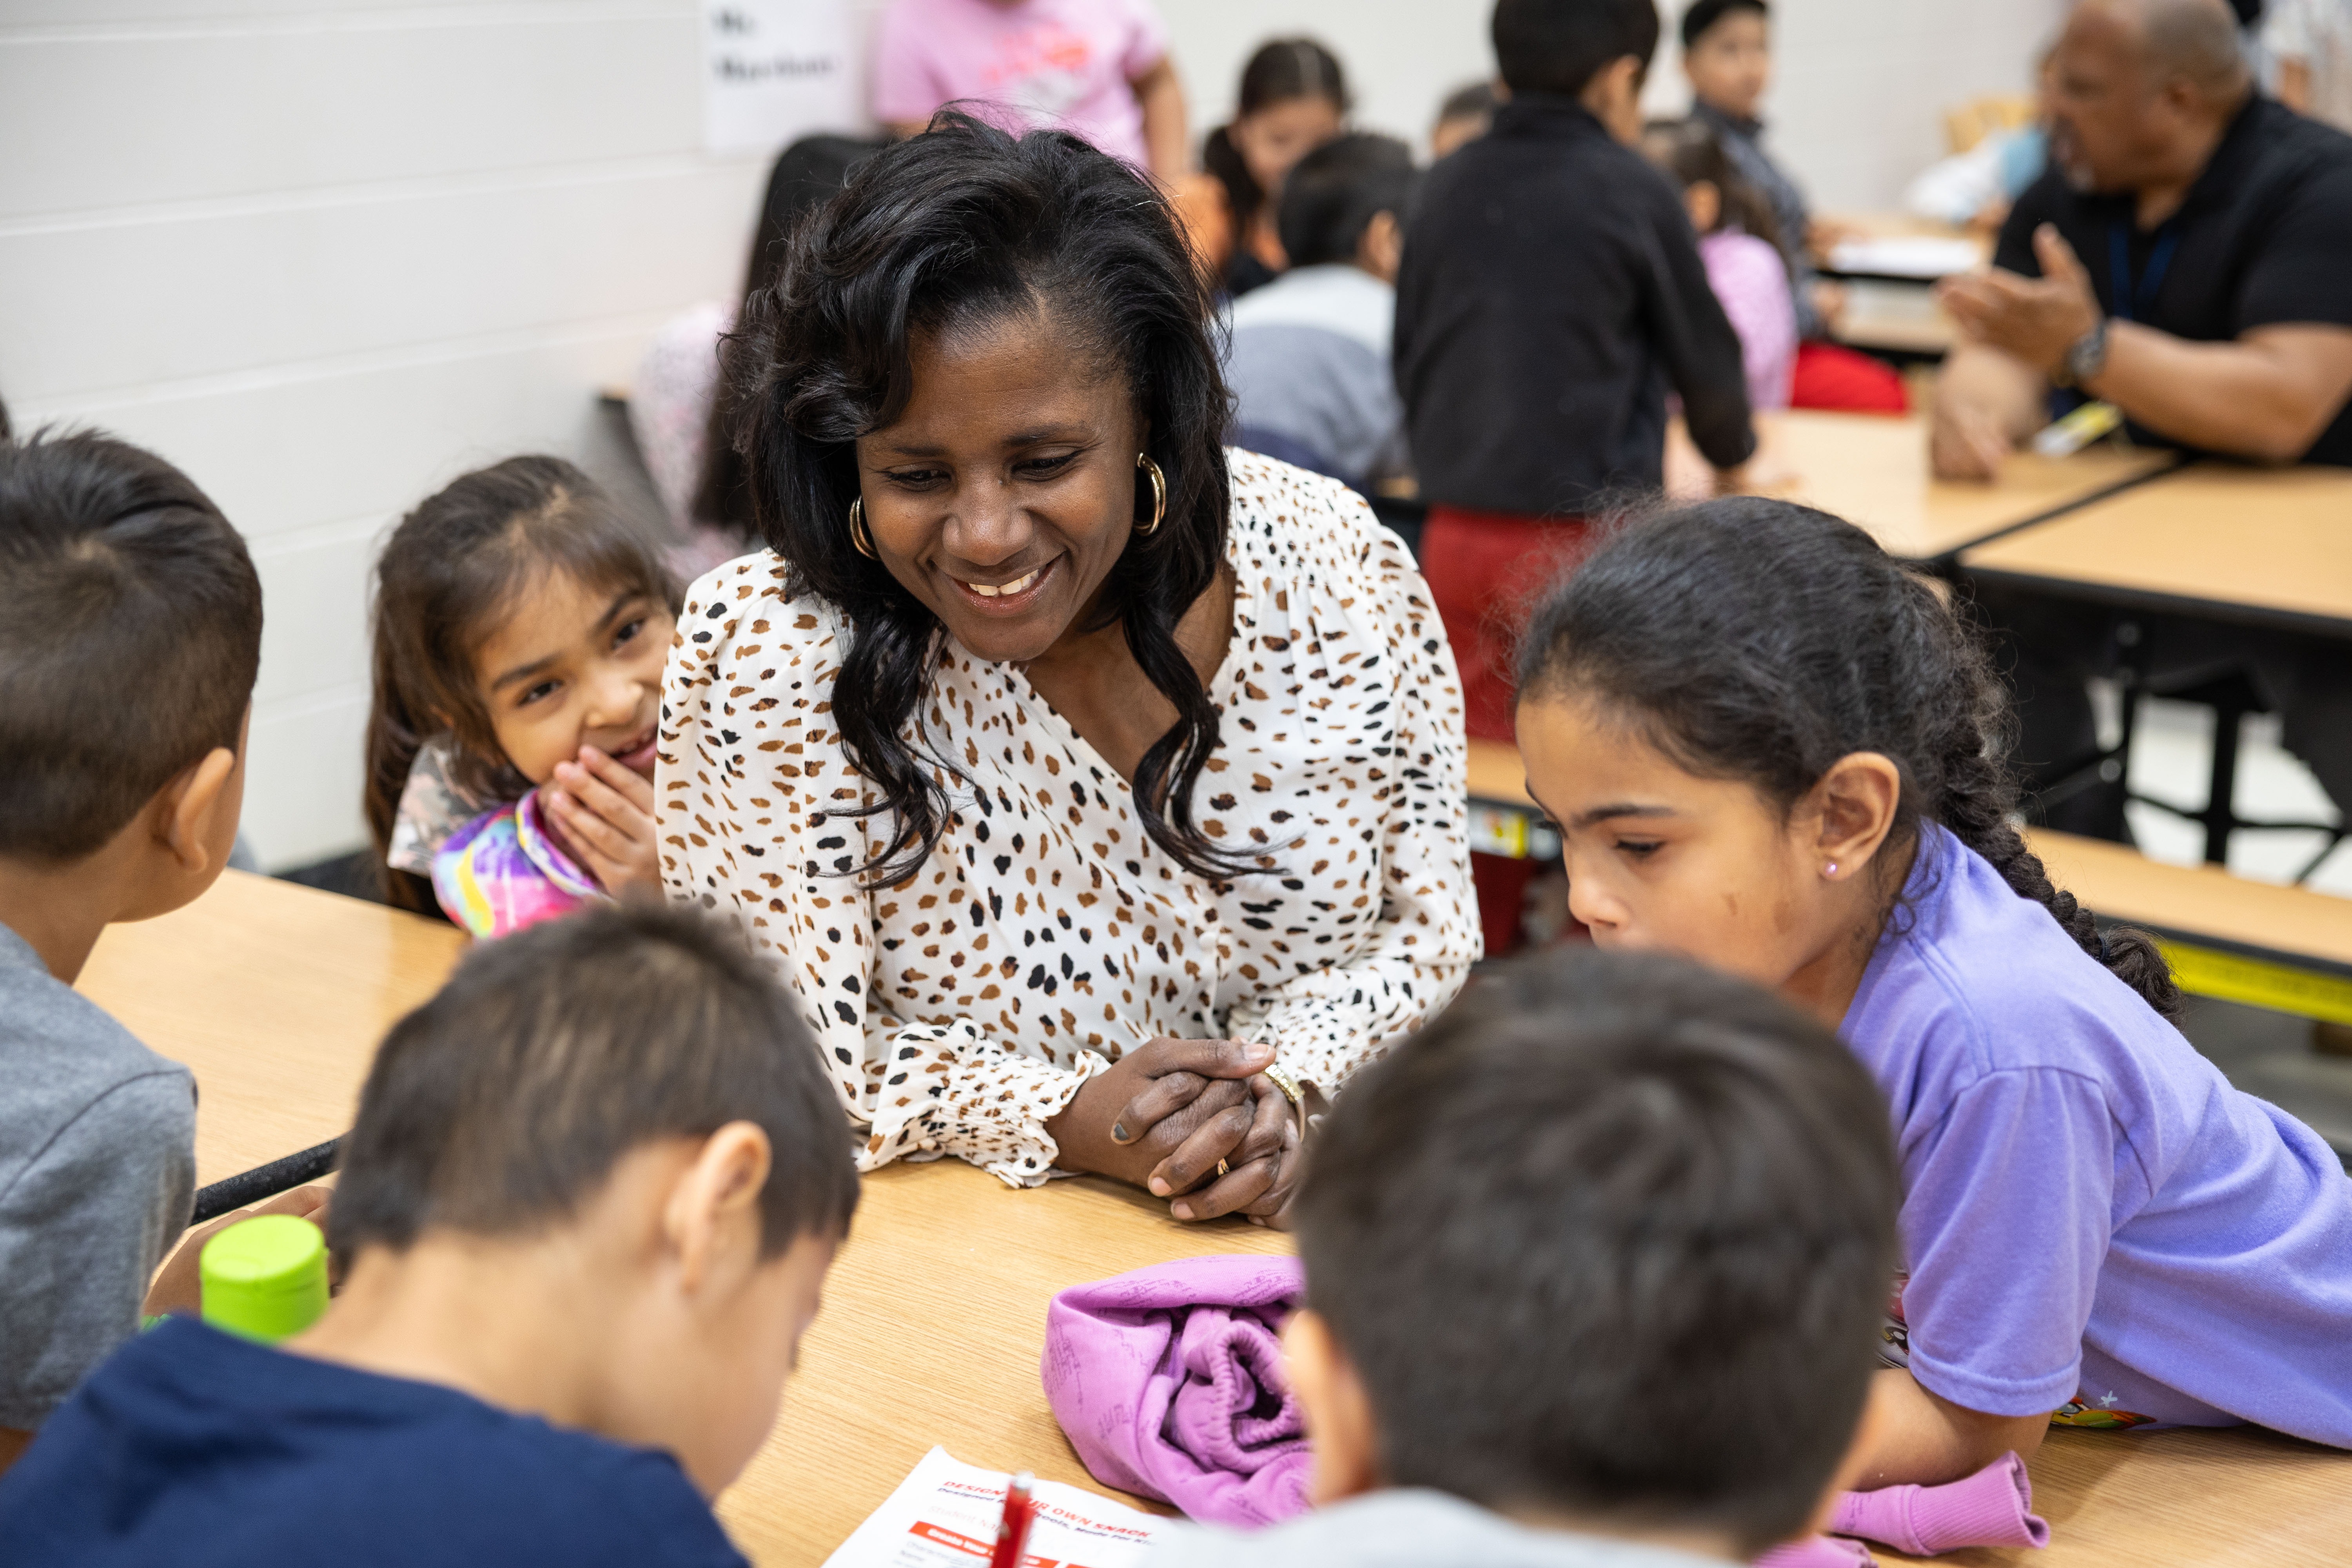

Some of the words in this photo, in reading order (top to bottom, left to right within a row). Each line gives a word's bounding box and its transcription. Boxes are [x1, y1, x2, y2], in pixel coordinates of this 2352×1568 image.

[938, 1488, 995, 1501] Designed
[943, 1481, 1006, 1495] DESIGN
[1024, 1500, 1050, 1510] UR
[1052, 1508, 1092, 1525] OWN
[1094, 1523, 1152, 1537] SNACK
